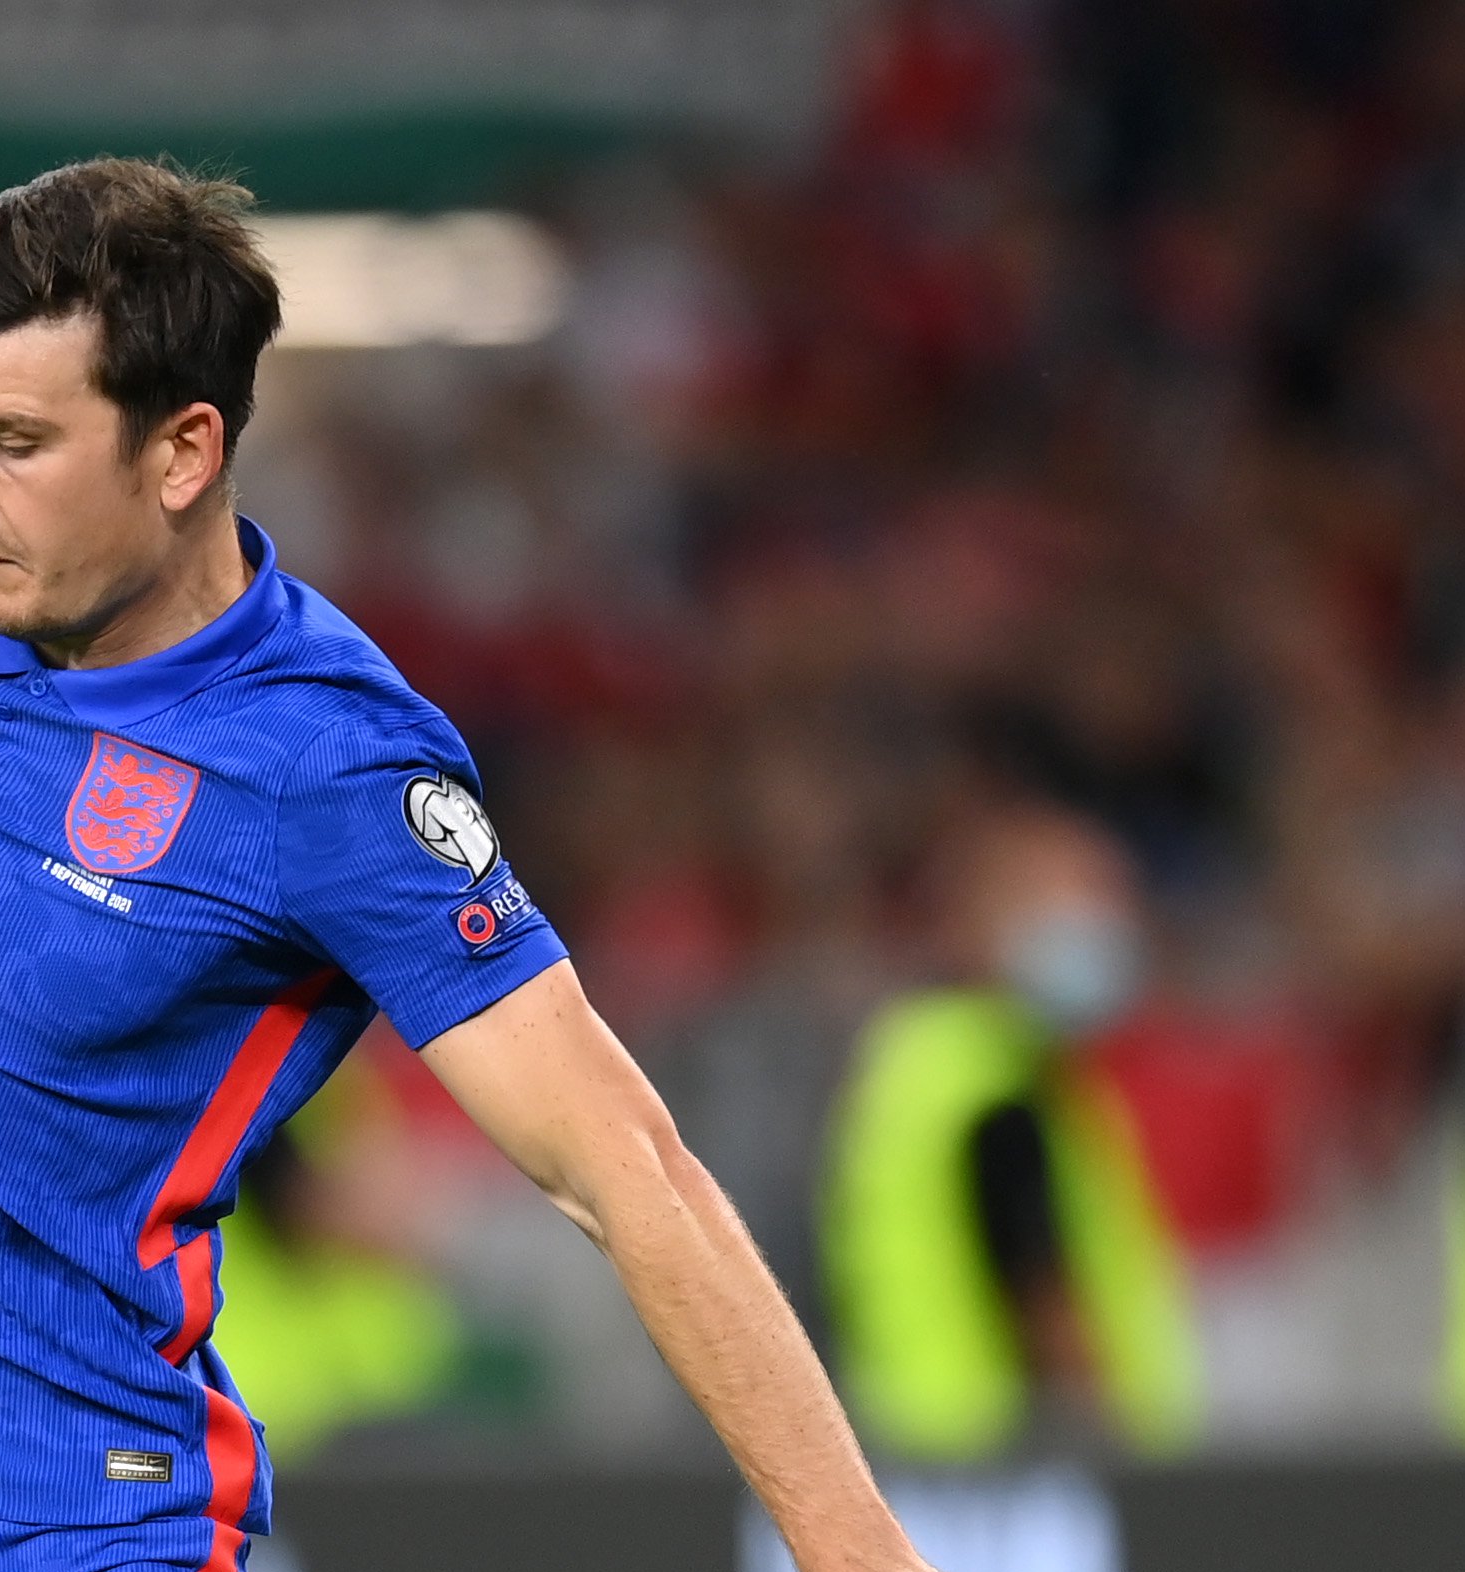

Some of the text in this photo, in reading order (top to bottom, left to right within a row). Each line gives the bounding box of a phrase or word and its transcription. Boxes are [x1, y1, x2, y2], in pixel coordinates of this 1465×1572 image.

[42, 857, 132, 913] 2 SEPTEMBER 2021
